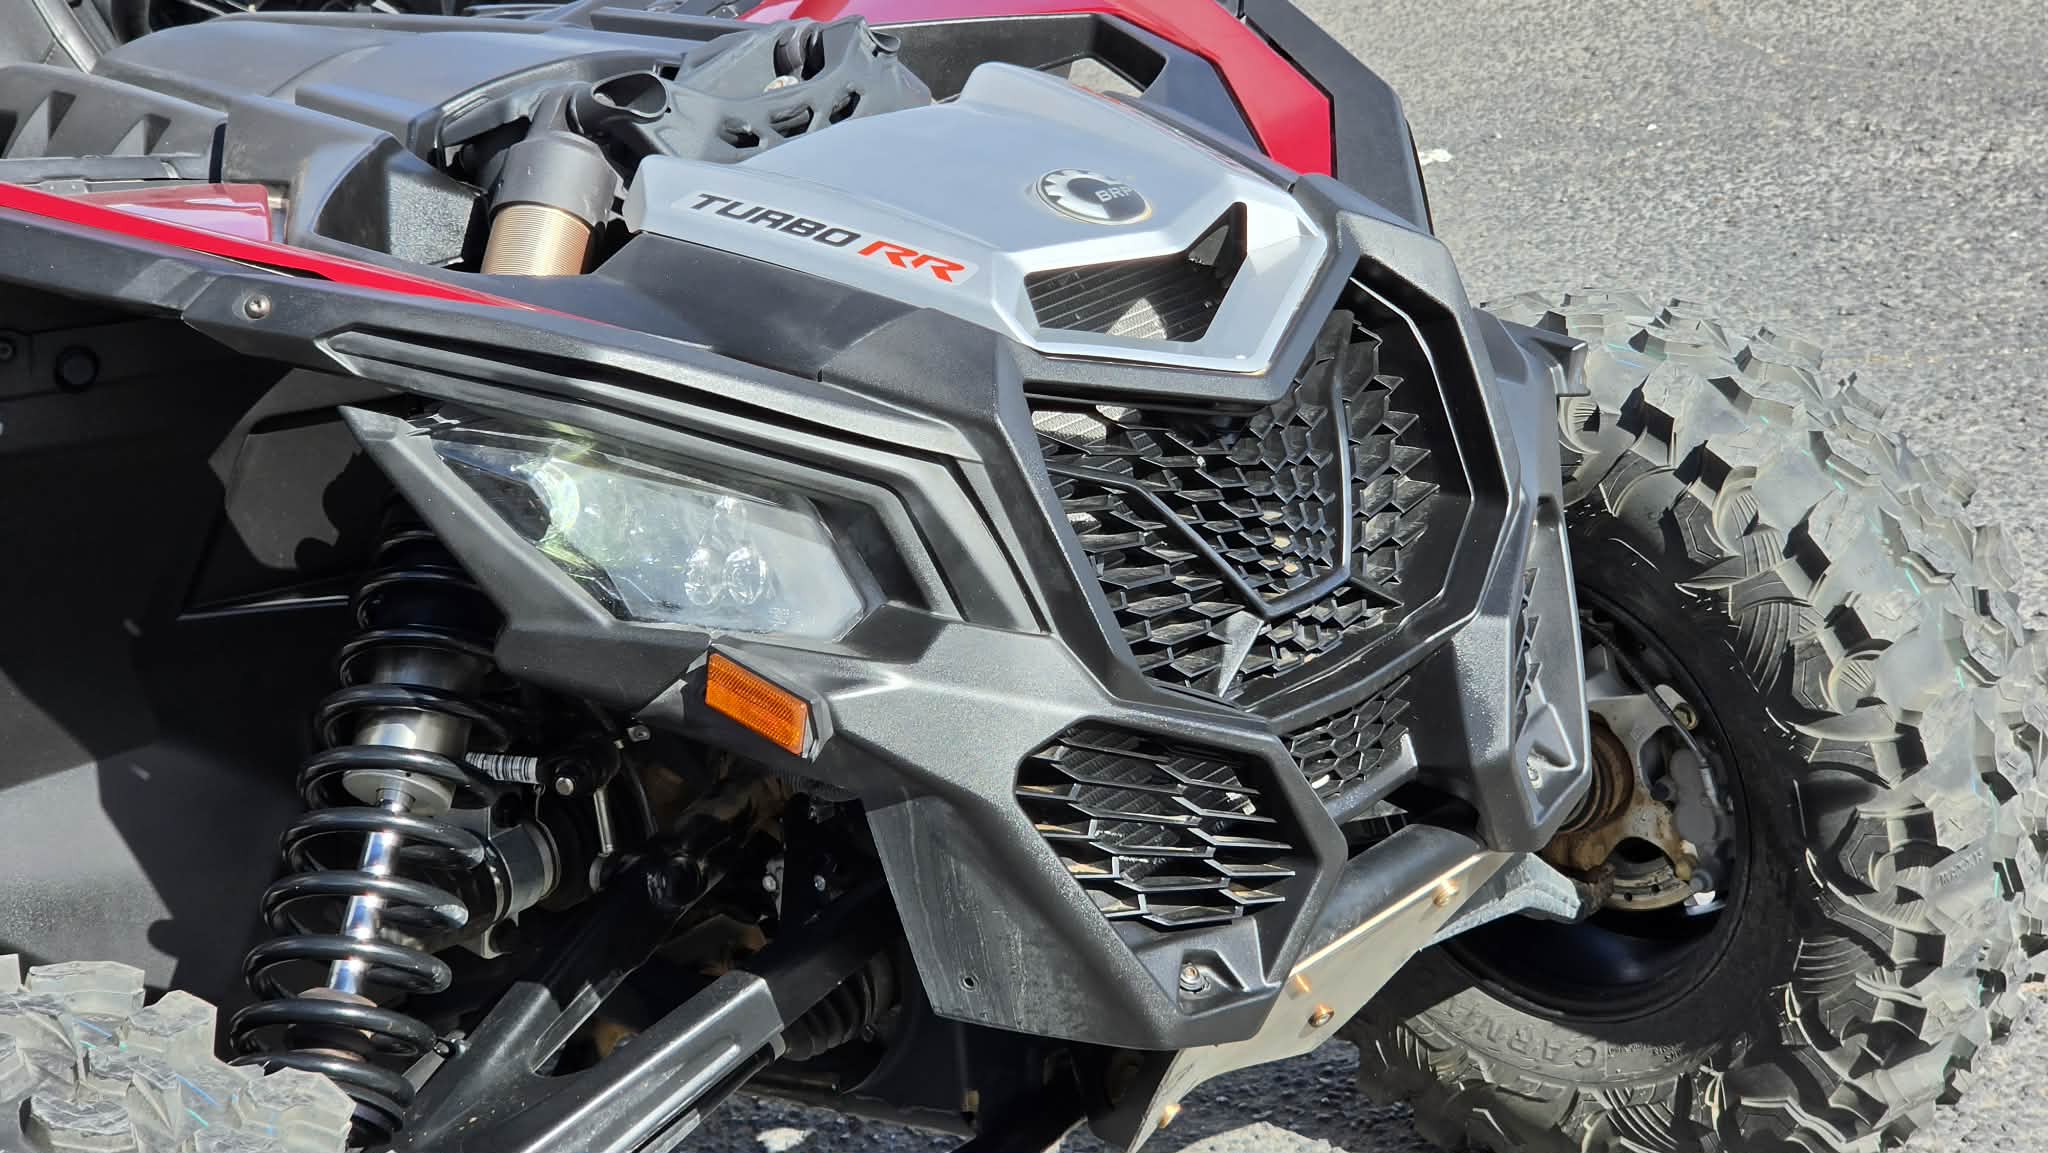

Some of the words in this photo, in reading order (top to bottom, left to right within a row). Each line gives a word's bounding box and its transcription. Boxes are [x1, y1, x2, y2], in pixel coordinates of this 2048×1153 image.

[1095, 185, 1133, 203] BRP
[690, 193, 862, 248] TURBO
[857, 240, 966, 283] RR
